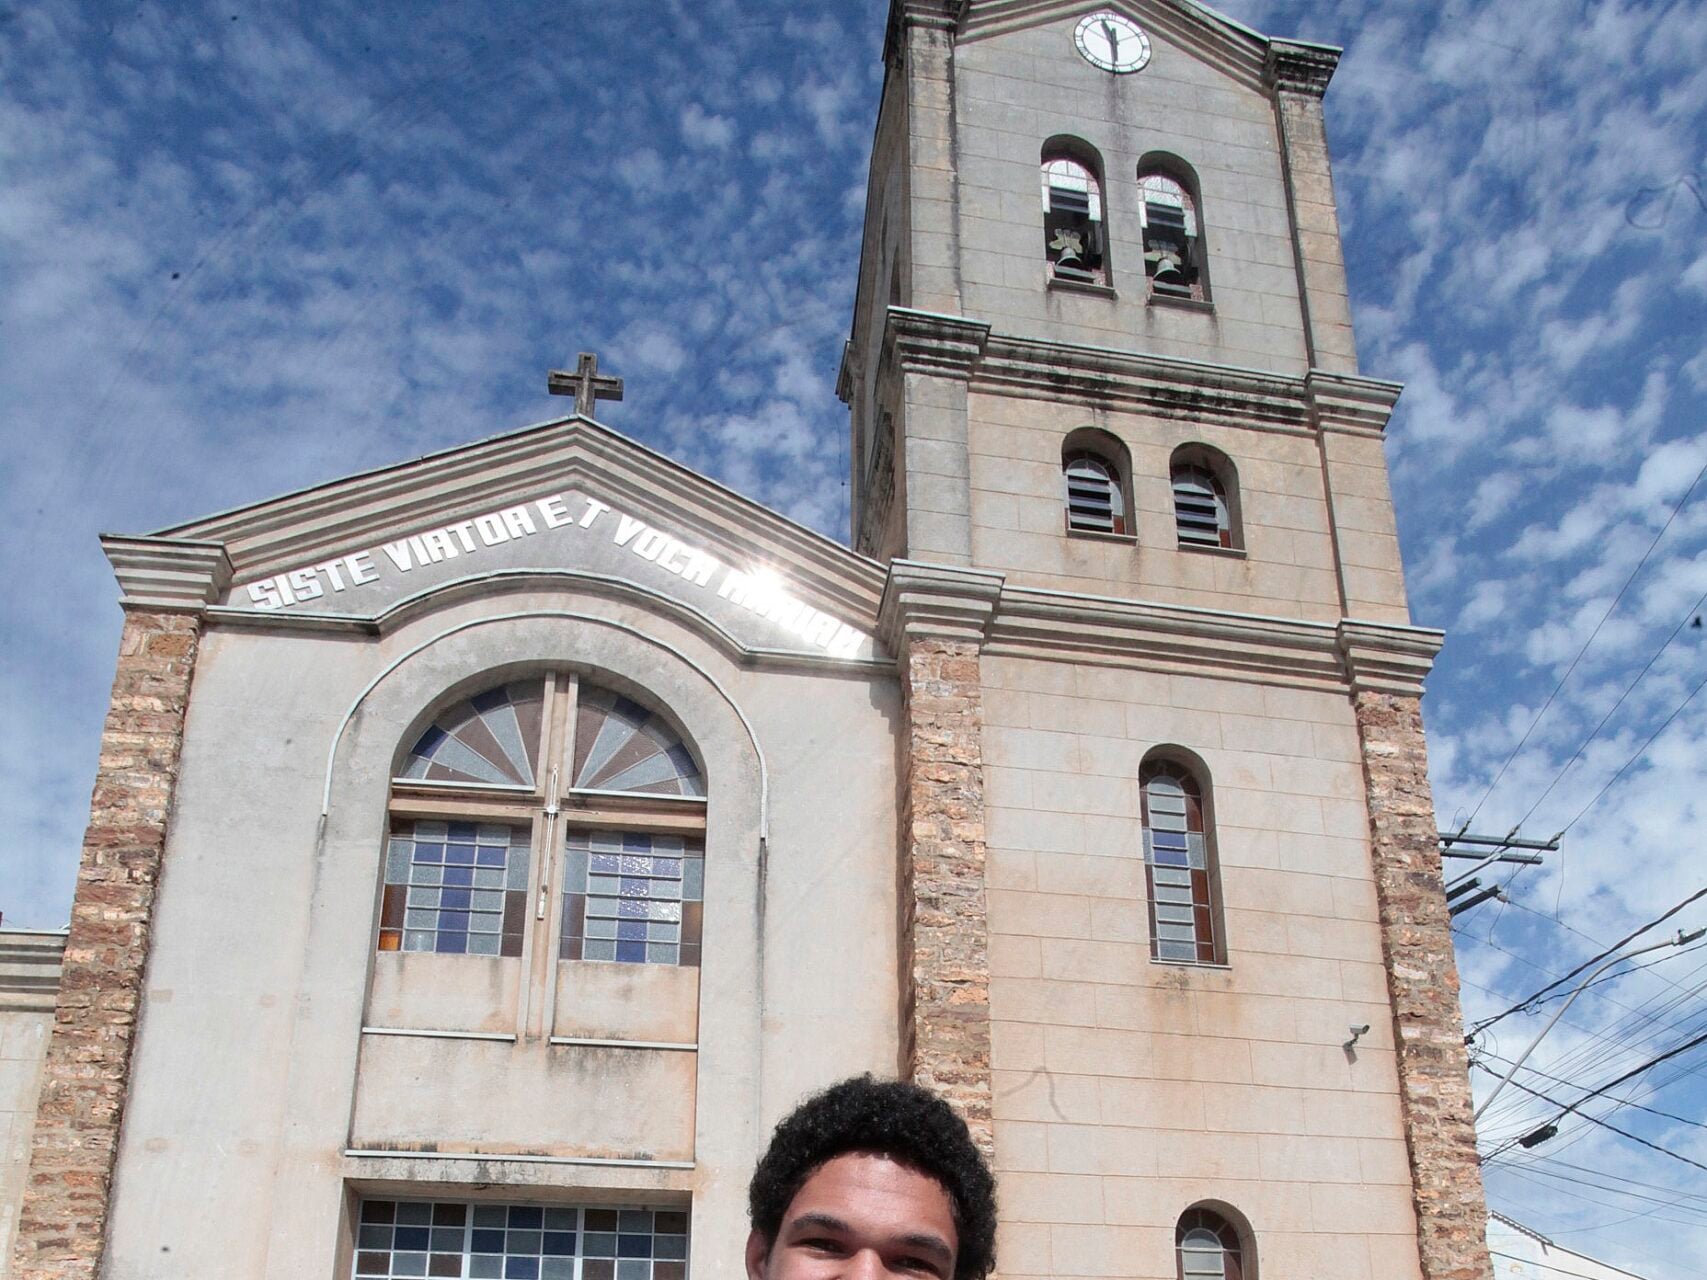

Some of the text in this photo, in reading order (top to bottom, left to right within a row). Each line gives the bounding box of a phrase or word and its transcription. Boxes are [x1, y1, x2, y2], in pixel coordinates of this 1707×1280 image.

[246, 551, 380, 610] SISTE
[381, 507, 536, 572] VIATOR
[614, 513, 720, 588] VOCA
